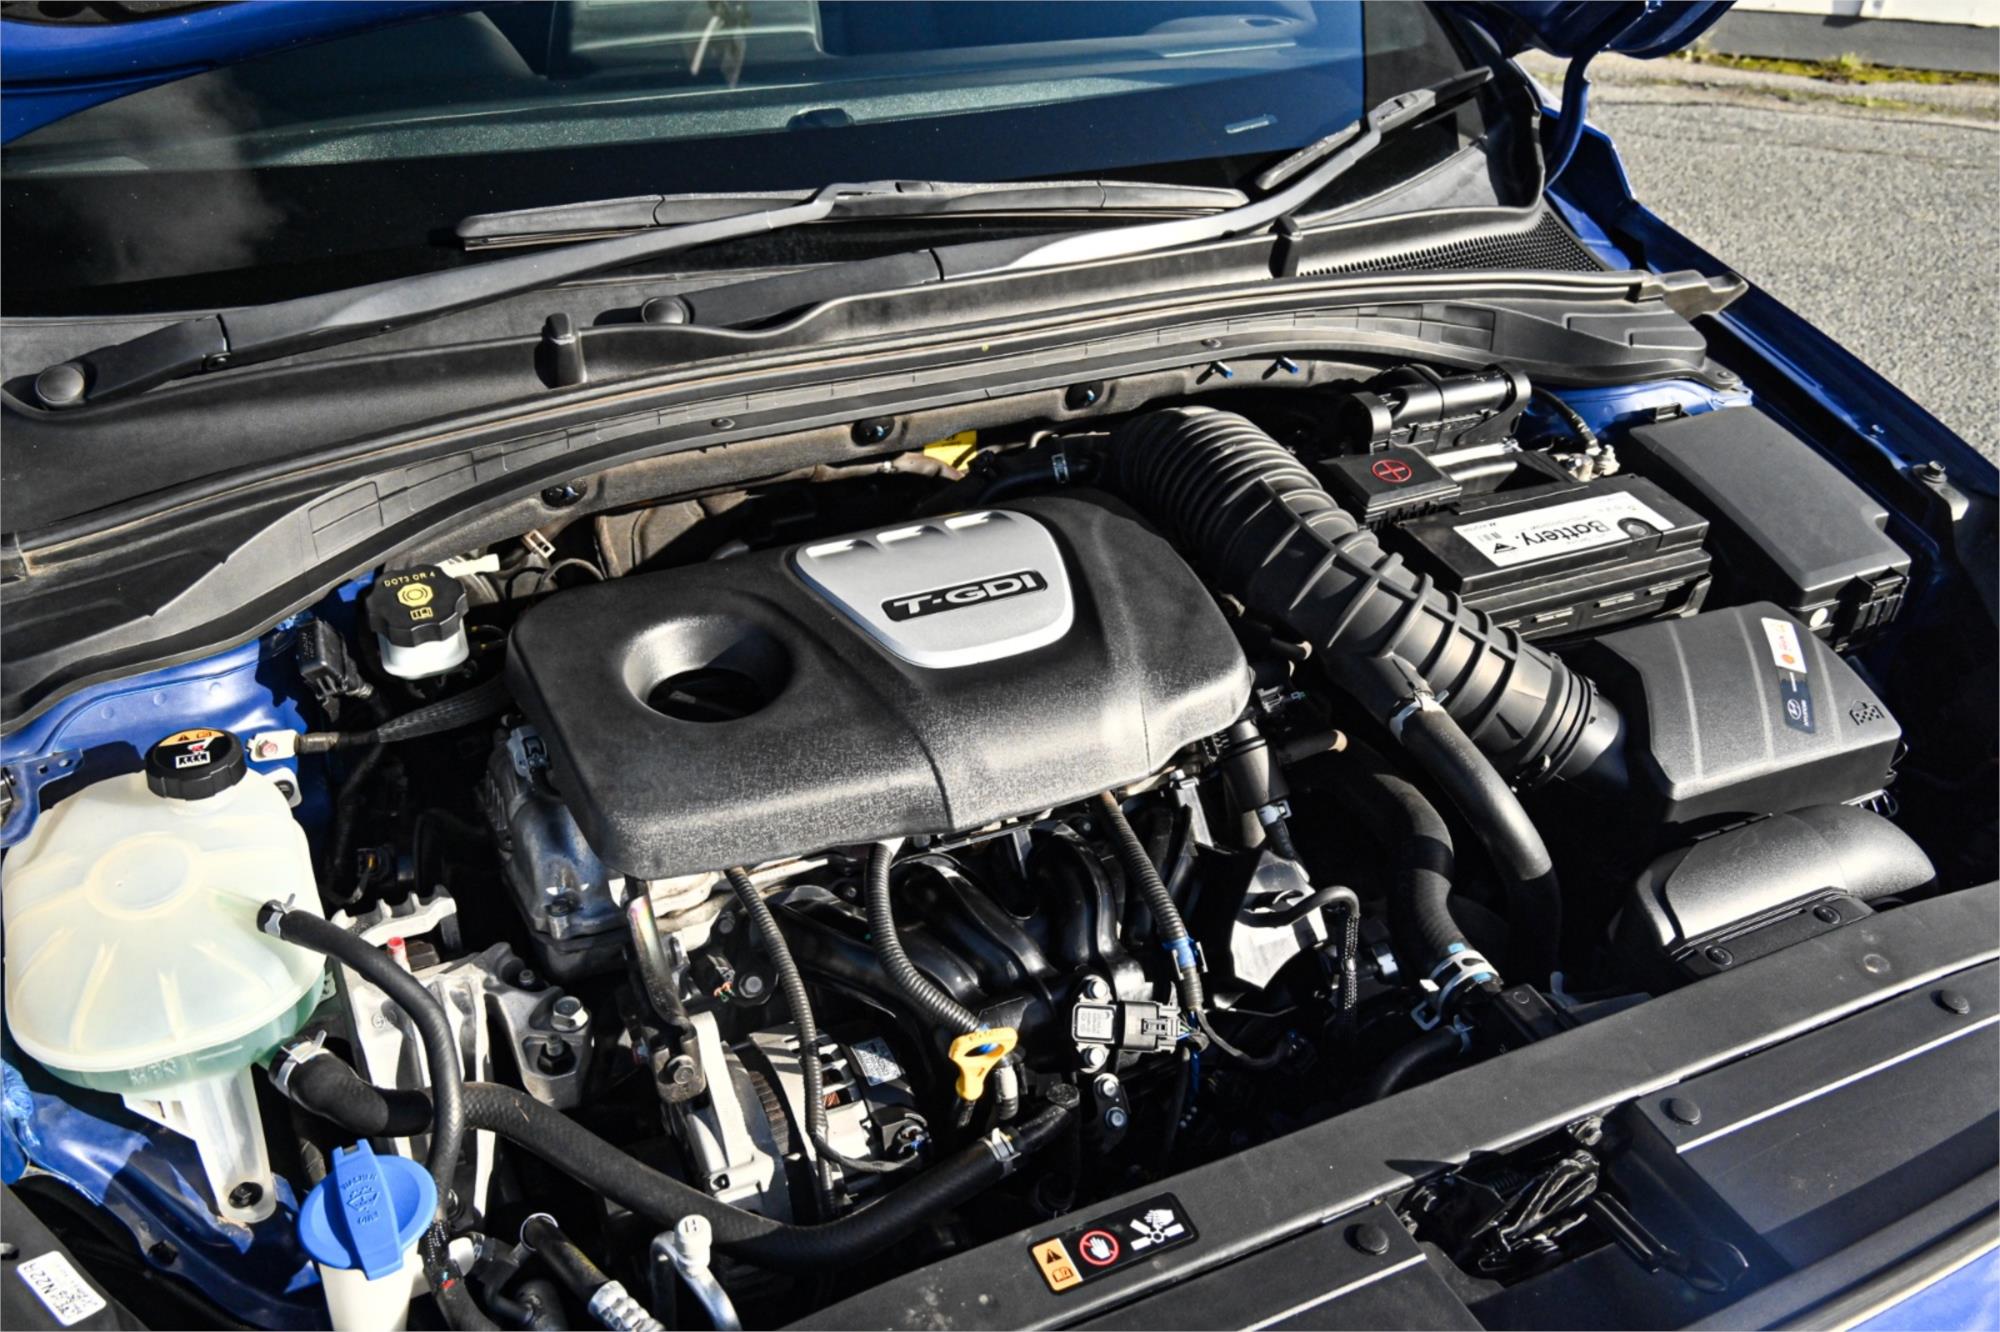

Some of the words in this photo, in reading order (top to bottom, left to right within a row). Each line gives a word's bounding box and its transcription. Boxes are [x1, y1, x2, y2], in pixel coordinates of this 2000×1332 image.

[384, 575, 410, 587] DOT3
[412, 573, 427, 581] OR
[893, 574, 1038, 615] T-GDI
